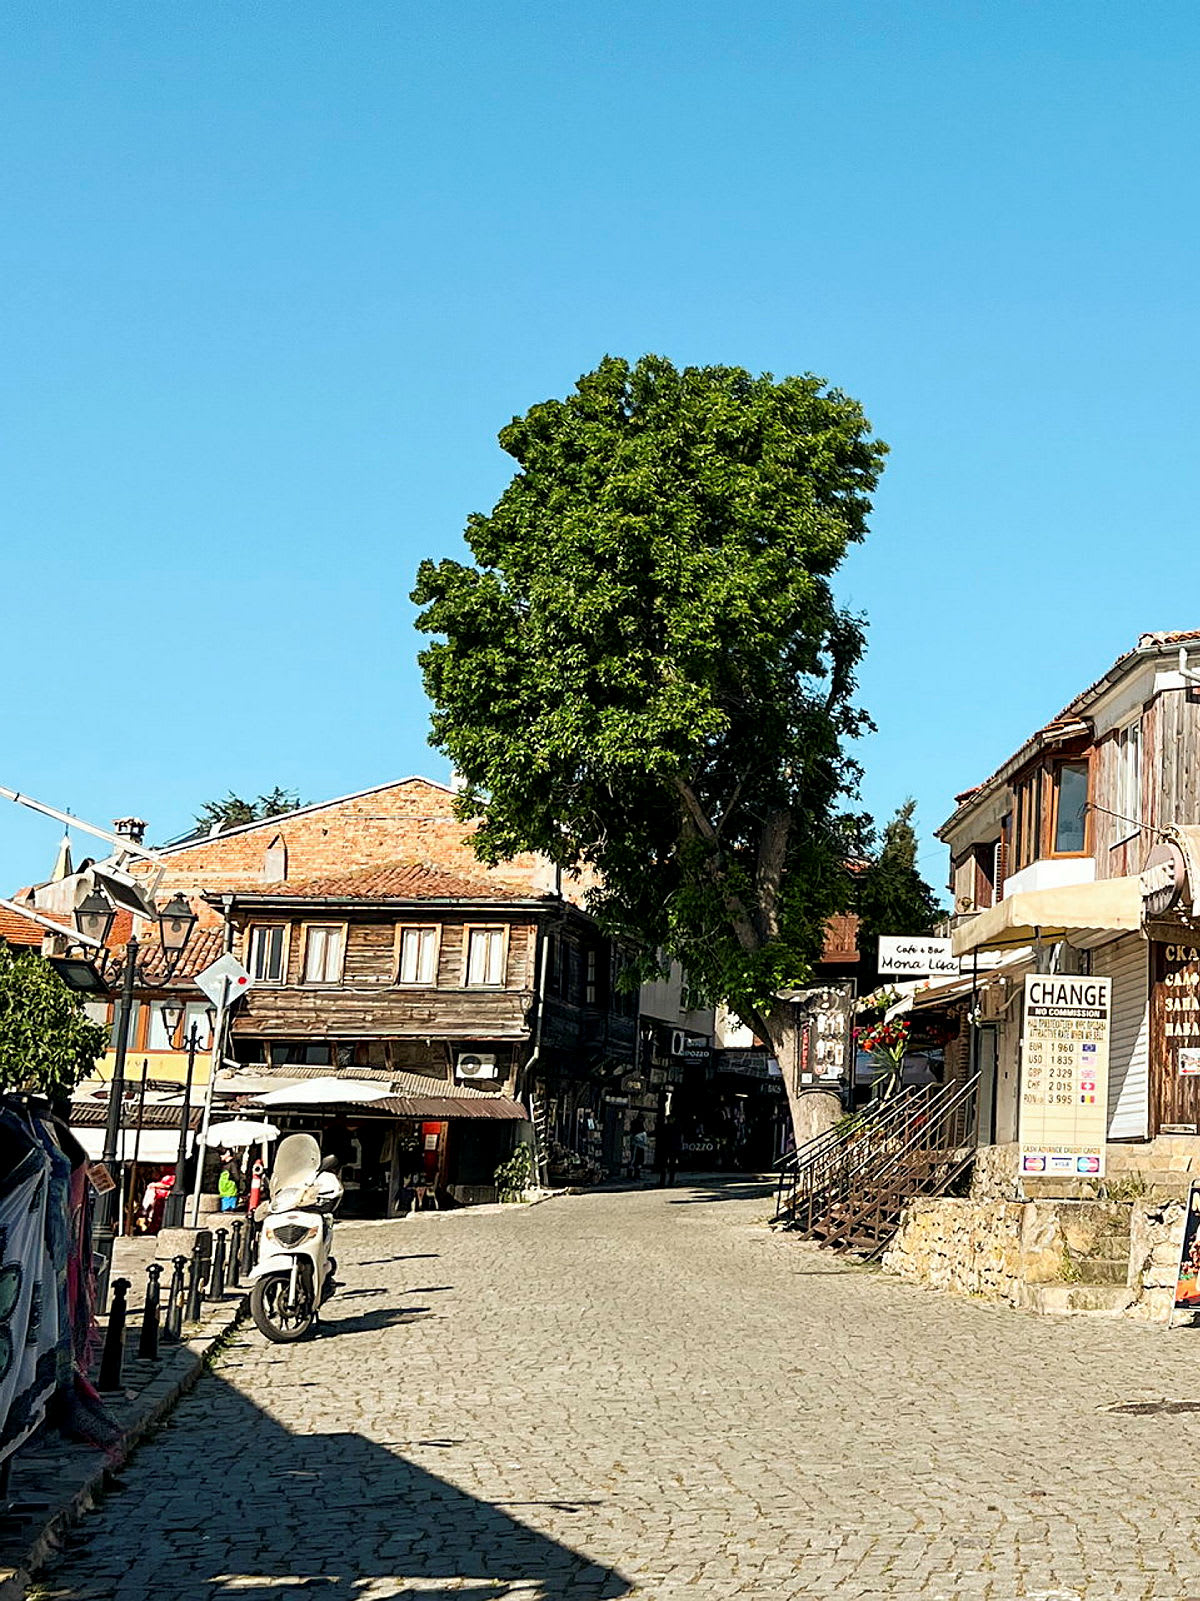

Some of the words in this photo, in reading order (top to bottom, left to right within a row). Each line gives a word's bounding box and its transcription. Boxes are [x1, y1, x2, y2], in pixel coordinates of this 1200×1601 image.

[928, 946, 945, 954] Bar
[882, 956, 925, 969] Mona
[929, 958, 958, 971] Lisa
[1030, 982, 1106, 1006] CHANGE
[1048, 1008, 1100, 1018] COMMISSION
[1029, 1042, 1042, 1051] EUR
[1029, 1055, 1042, 1064] USD
